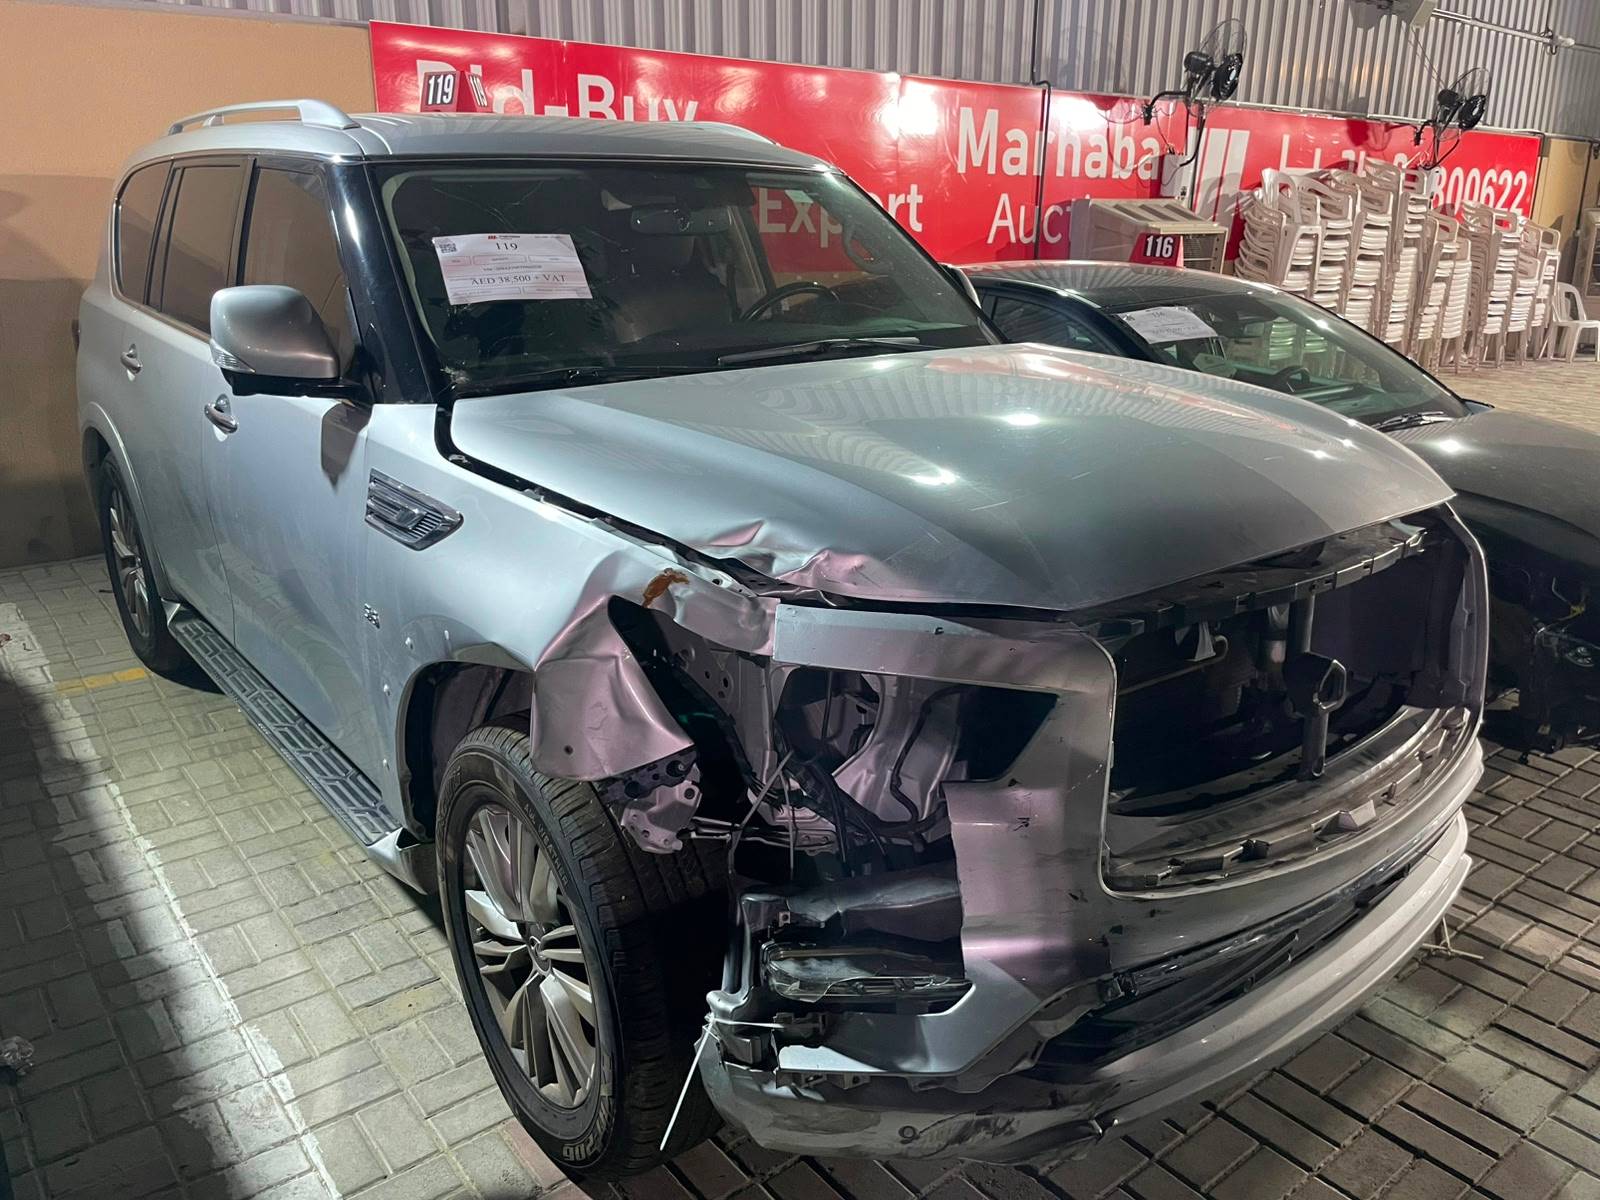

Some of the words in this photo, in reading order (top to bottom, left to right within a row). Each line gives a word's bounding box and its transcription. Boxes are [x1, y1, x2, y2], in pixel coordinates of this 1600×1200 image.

[416, 59, 698, 122] d-Buy
[427, 74, 454, 105] 119
[957, 107, 1160, 181] Marhaba
[759, 184, 924, 248] Exprt
[1431, 166, 1528, 216] 800622
[986, 193, 1091, 244] Auc
[495, 242, 518, 250] 119
[1146, 235, 1174, 258] 116
[471, 277, 496, 286] AED
[543, 274, 566, 283] VAT
